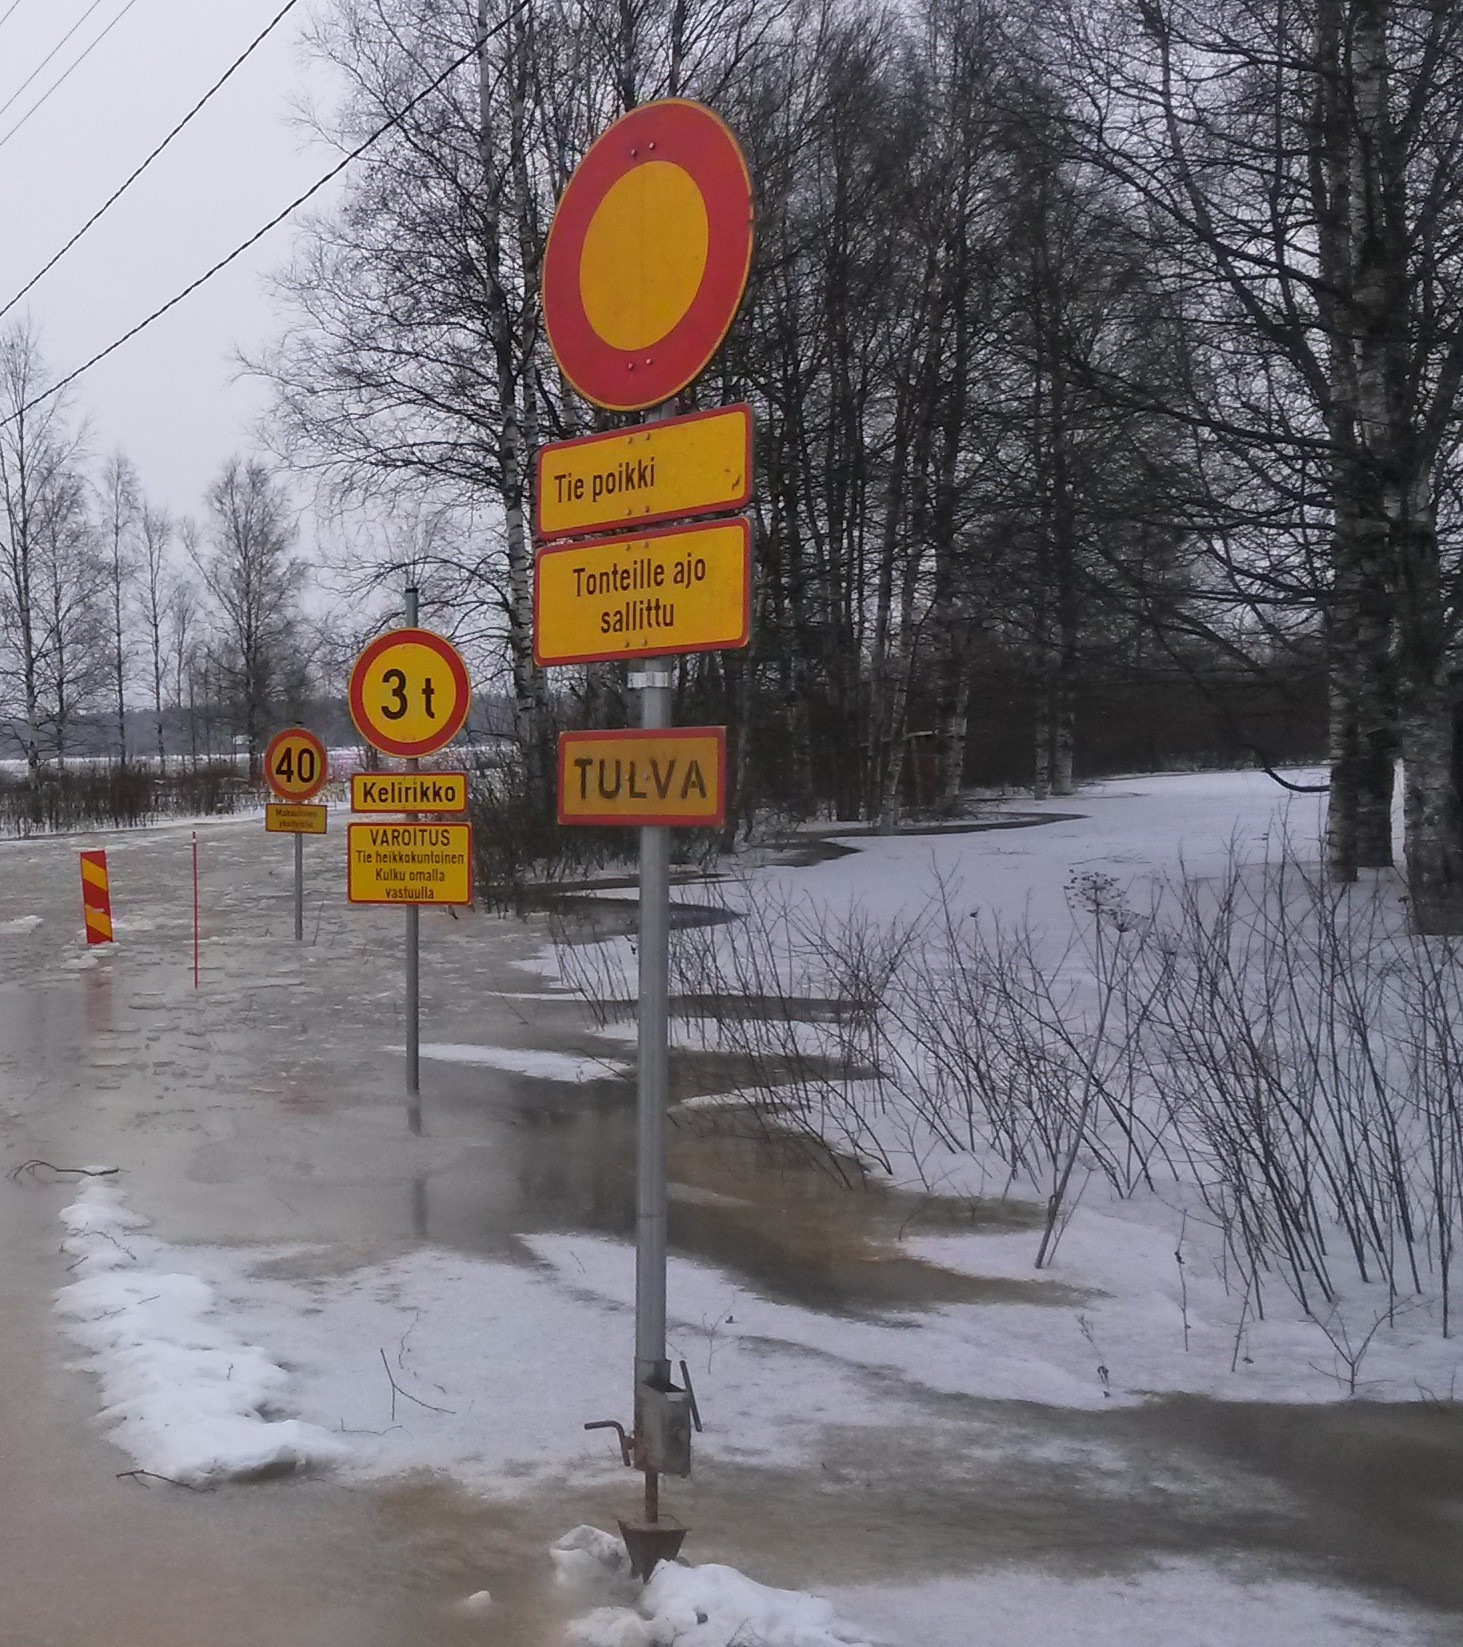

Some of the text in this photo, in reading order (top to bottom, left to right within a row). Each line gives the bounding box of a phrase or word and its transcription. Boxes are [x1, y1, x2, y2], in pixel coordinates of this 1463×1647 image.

[554, 457, 655, 503] Tie poikki
[573, 552, 706, 597] Tonteille ajo
[601, 599, 674, 633] sallittu
[381, 669, 435, 720] 3 t
[276, 747, 314, 783] 40
[574, 758, 707, 800] TULVA
[363, 782, 456, 803] Kelirikko
[370, 829, 450, 847] VAROITUS
[356, 850, 464, 864] Tie heikkokuntoinen
[376, 868, 445, 882] Kulku omalla
[385, 886, 434, 899] vastuulla
